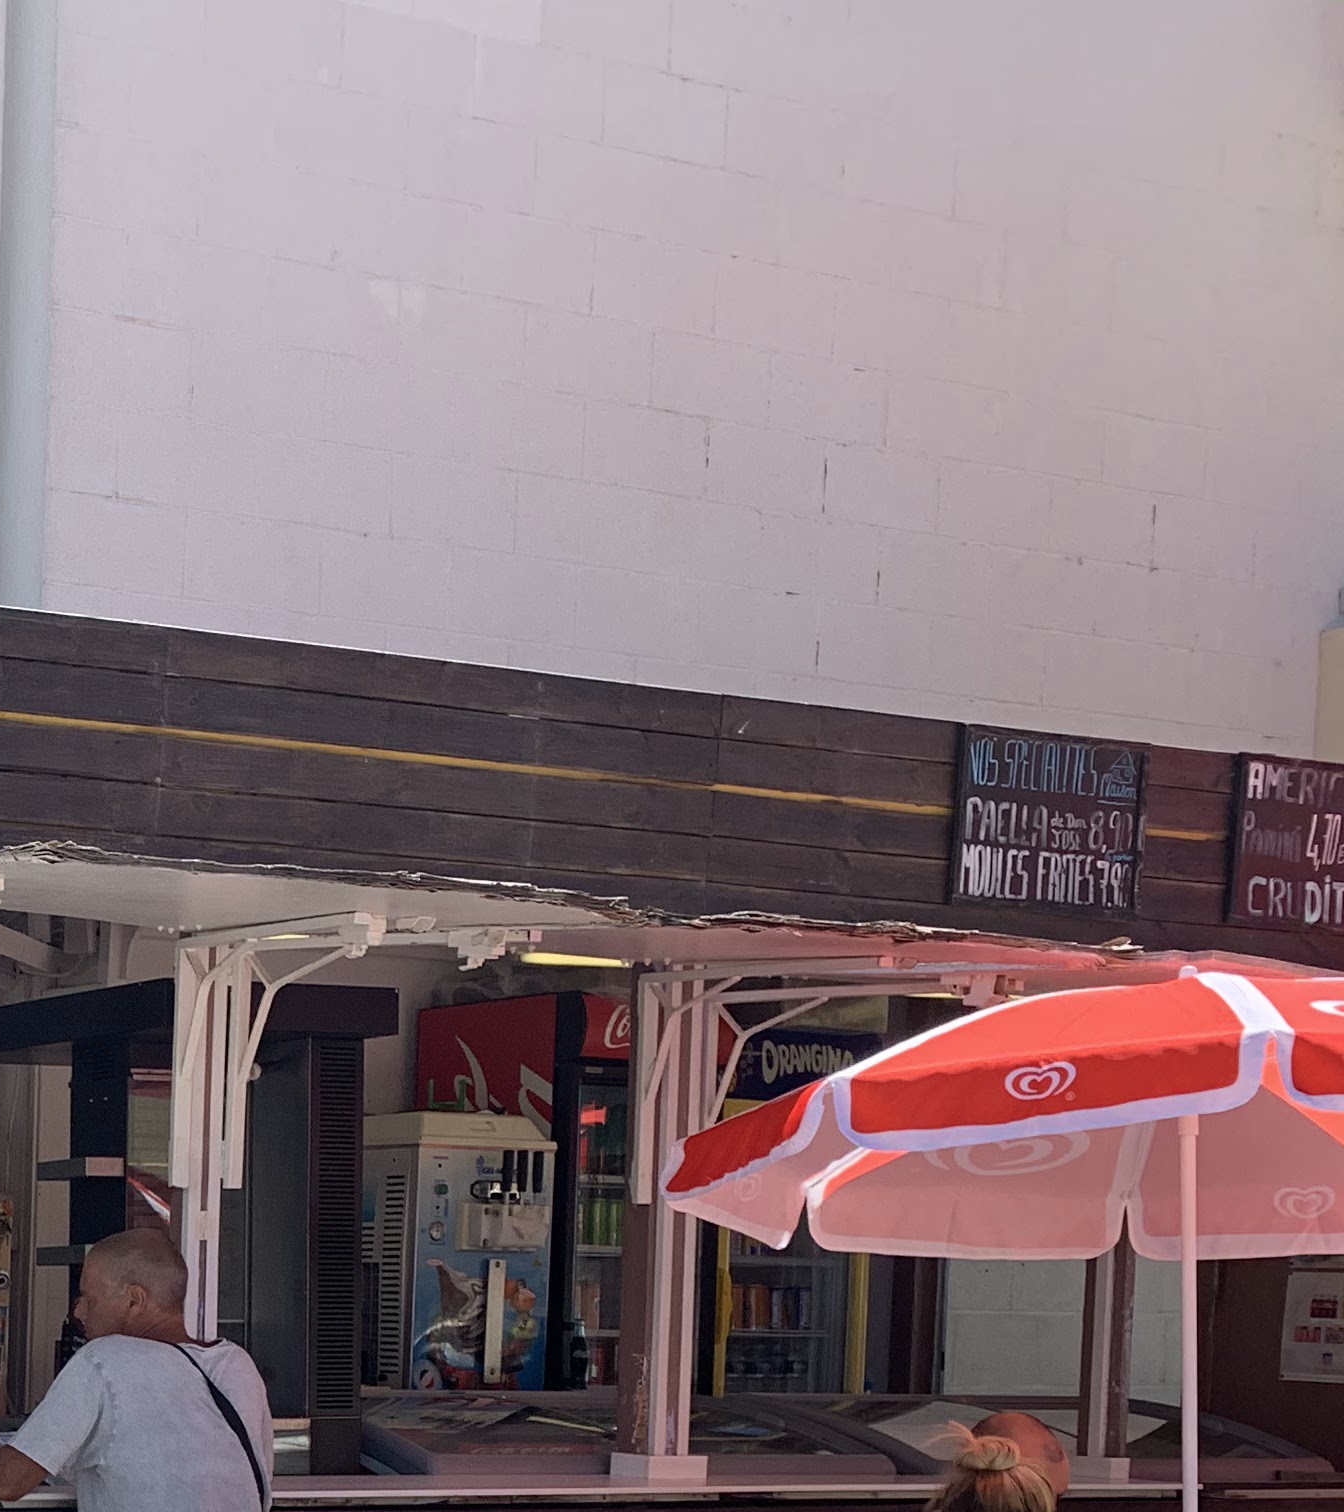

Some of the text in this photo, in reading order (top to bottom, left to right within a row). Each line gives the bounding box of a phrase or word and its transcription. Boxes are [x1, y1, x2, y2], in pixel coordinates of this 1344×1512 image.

[965, 796, 1048, 849] PAELLA
[960, 843, 1031, 899] MOULES
[1035, 851, 1096, 905] FRITES
